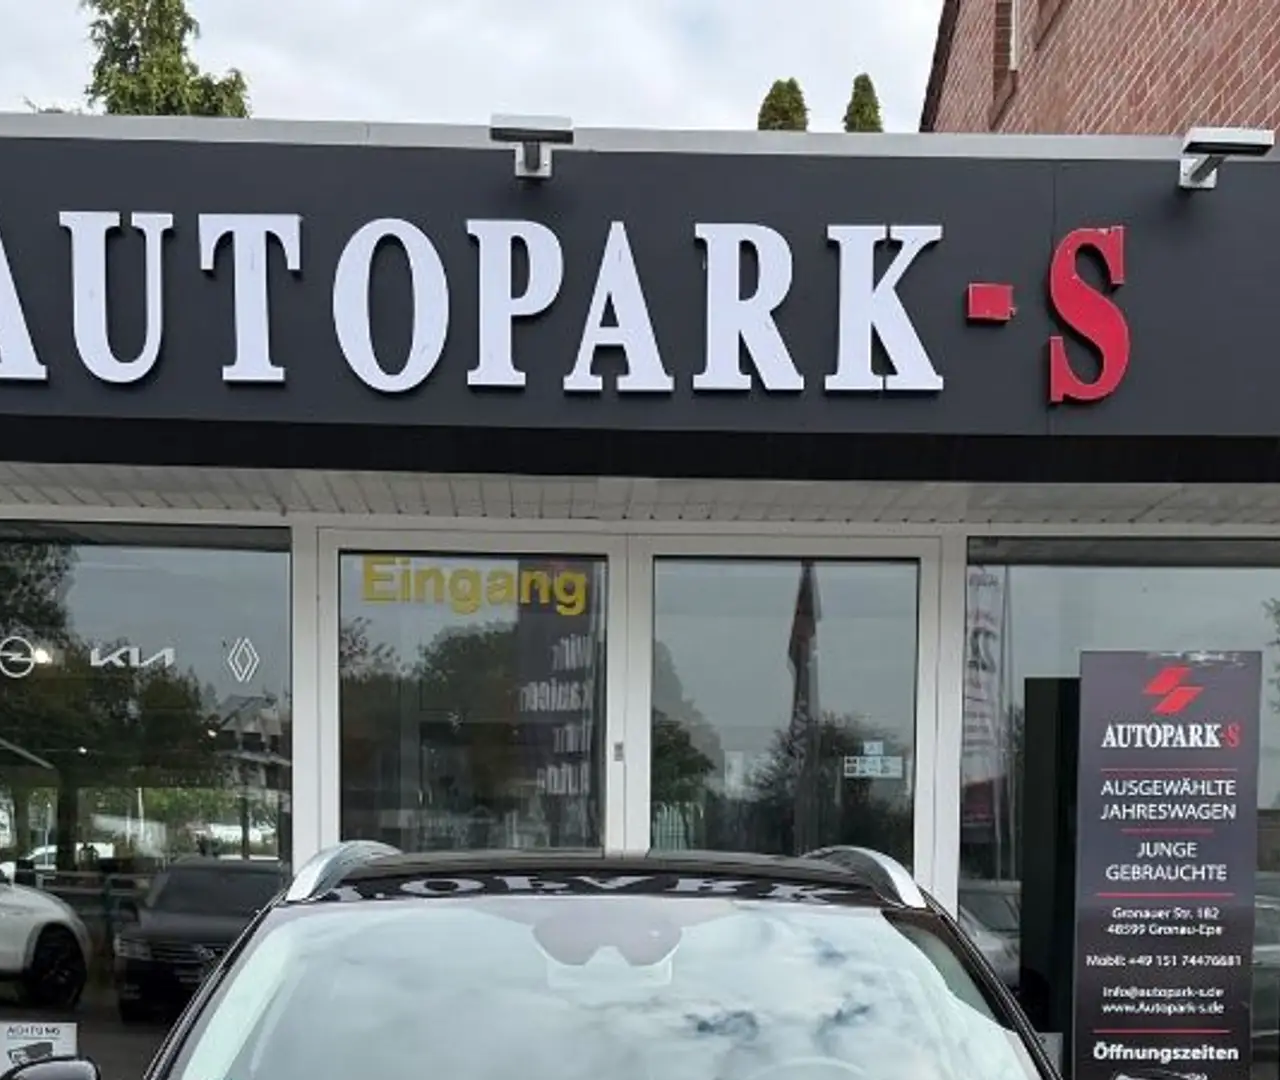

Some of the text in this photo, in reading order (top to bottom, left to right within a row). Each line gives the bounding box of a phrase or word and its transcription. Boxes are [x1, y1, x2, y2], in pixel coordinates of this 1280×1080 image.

[363, 554, 588, 616] Eingang
[1101, 779, 1236, 796] AUSGEWÄHLTE
[1100, 804, 1236, 820] JAHRESWAGEN
[1136, 842, 1198, 858] JUNGE
[1105, 865, 1228, 881] GEBRAUCHTE
[1112, 907, 1170, 919] Gronauer
[1093, 1042, 1239, 1064] Öffnungszeiten
